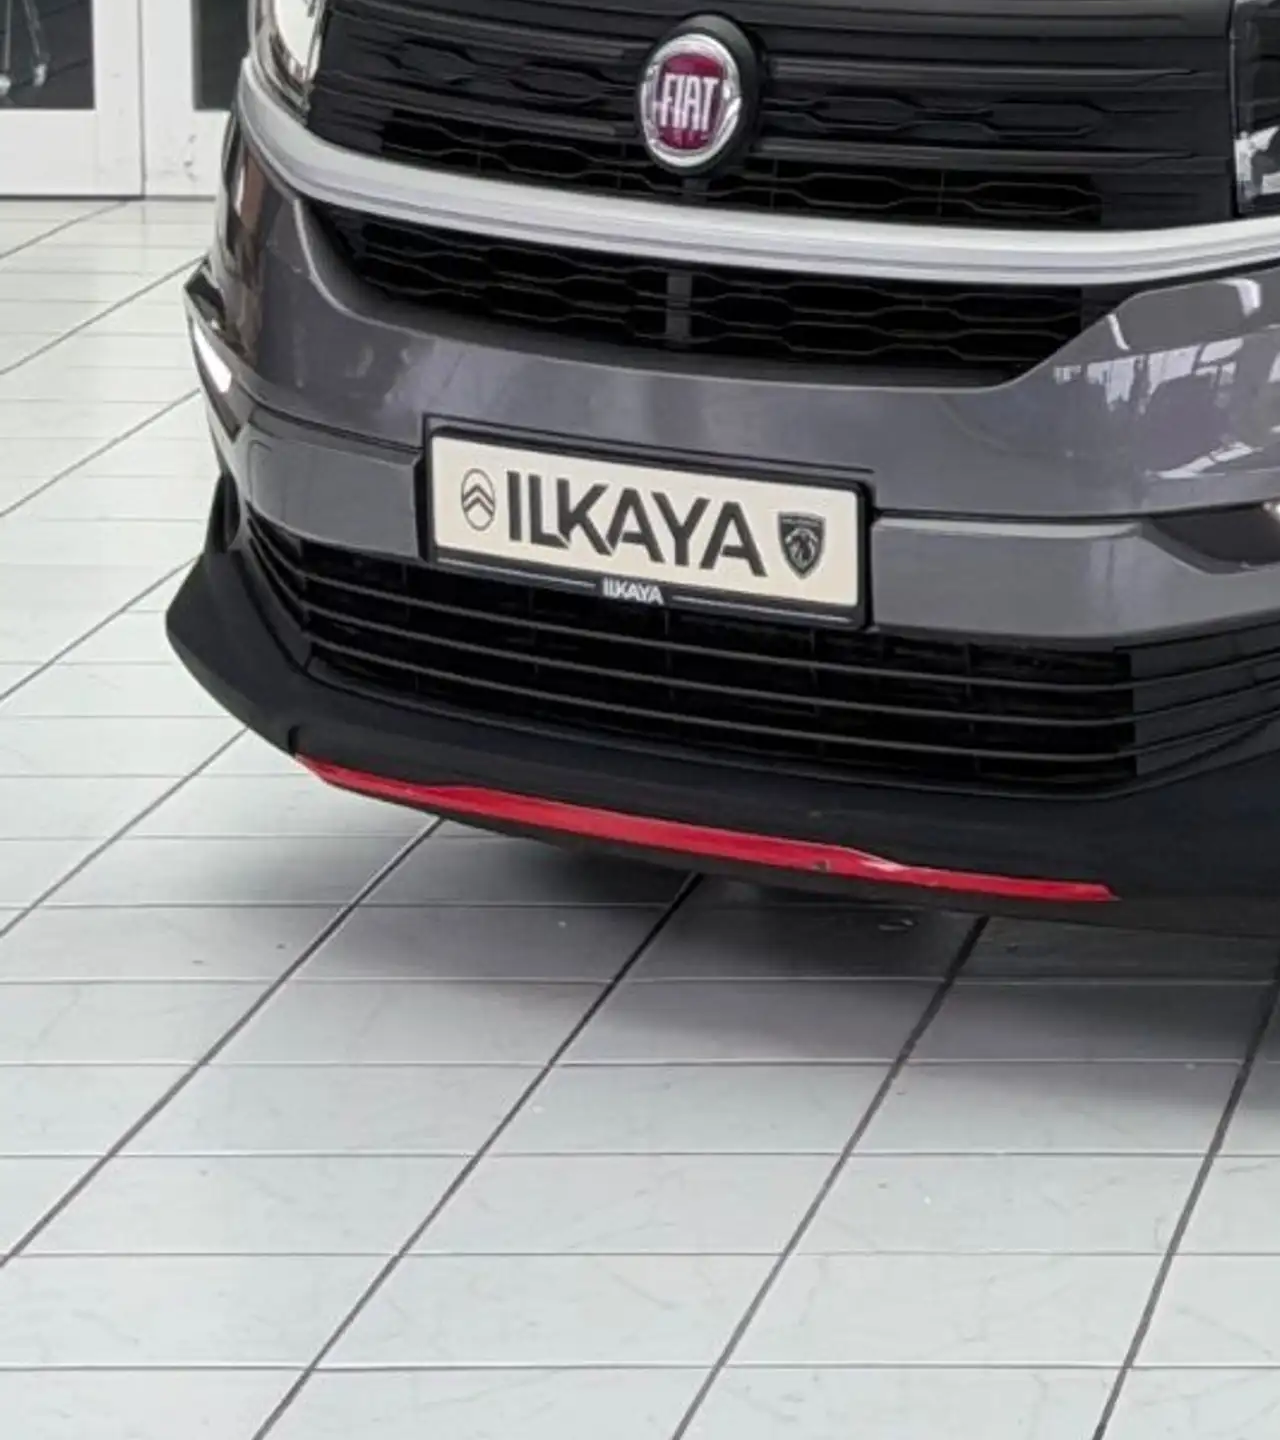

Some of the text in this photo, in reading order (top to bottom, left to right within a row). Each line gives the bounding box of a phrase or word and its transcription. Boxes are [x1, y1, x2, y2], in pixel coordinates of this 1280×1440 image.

[659, 72, 720, 132] FIAT
[506, 469, 768, 578] ILKAYA
[602, 578, 665, 606] ILKAYA
